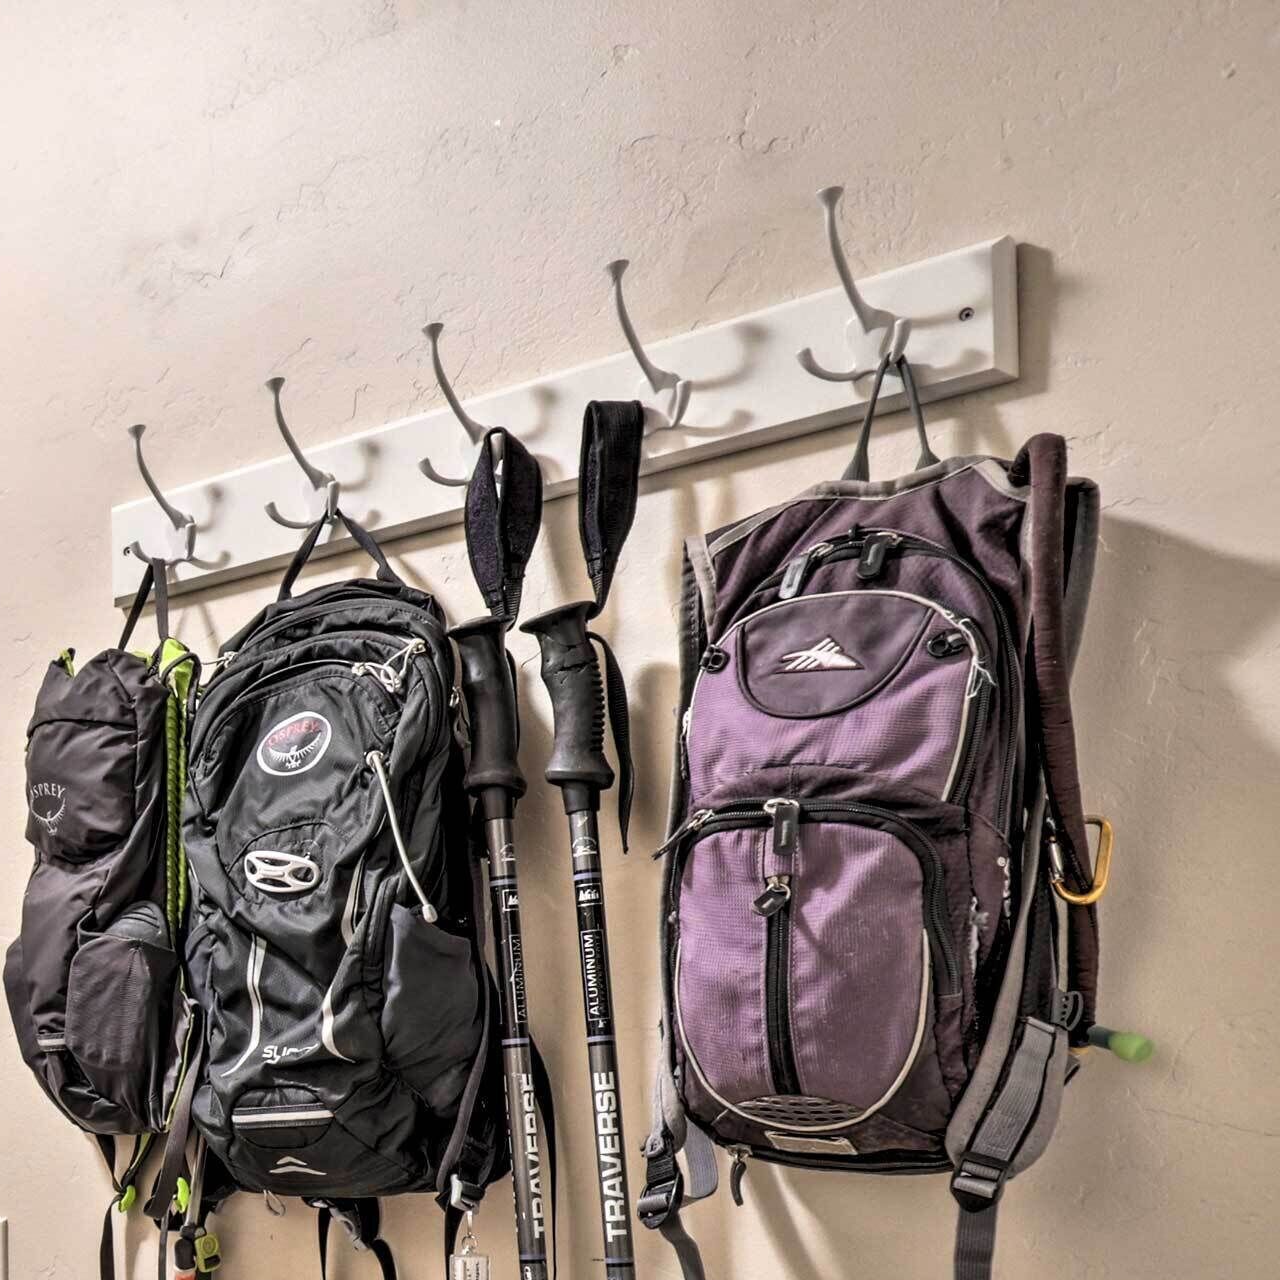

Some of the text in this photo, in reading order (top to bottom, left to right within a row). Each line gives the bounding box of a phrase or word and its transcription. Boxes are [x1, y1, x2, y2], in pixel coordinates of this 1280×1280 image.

[266, 720, 321, 749] OSPREY
[512, 939, 527, 1018] ALUMINUM
[583, 934, 600, 1015] ALUMINUM
[593, 1071, 627, 1243] TRAVERSE
